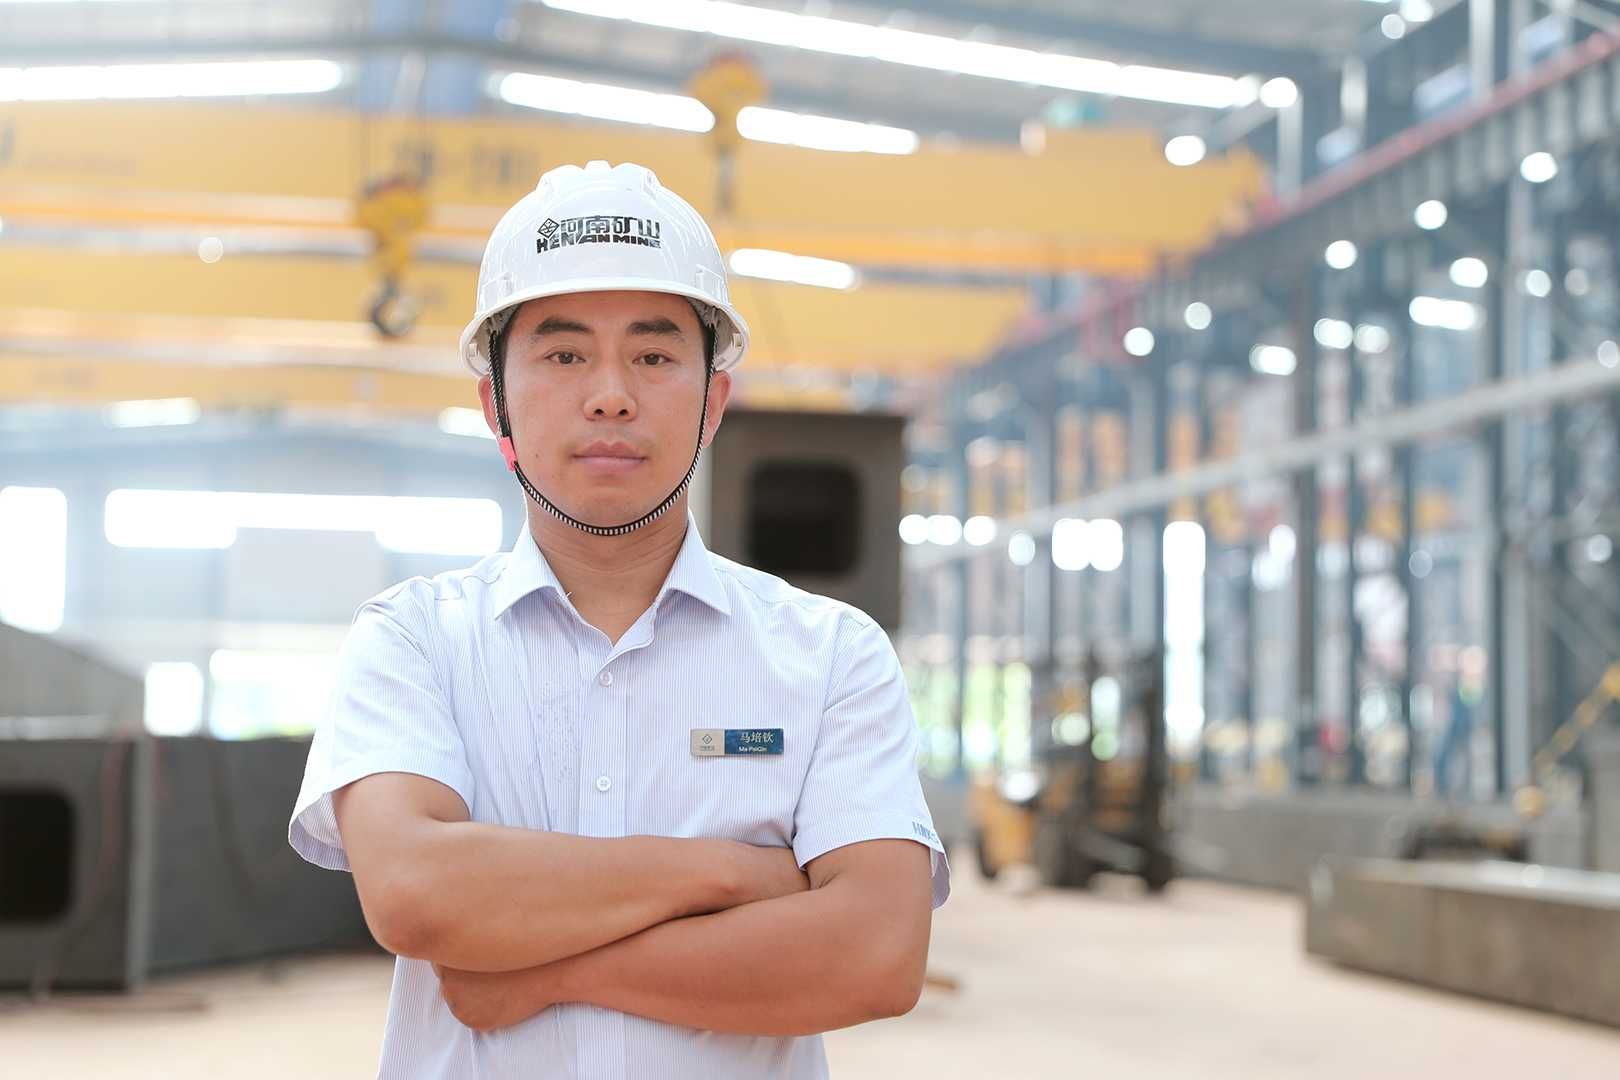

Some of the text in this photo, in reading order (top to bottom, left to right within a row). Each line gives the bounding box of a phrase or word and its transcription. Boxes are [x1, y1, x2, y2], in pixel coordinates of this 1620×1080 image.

[560, 215, 660, 239] 河南矿山
[536, 232, 610, 253] HENAN
